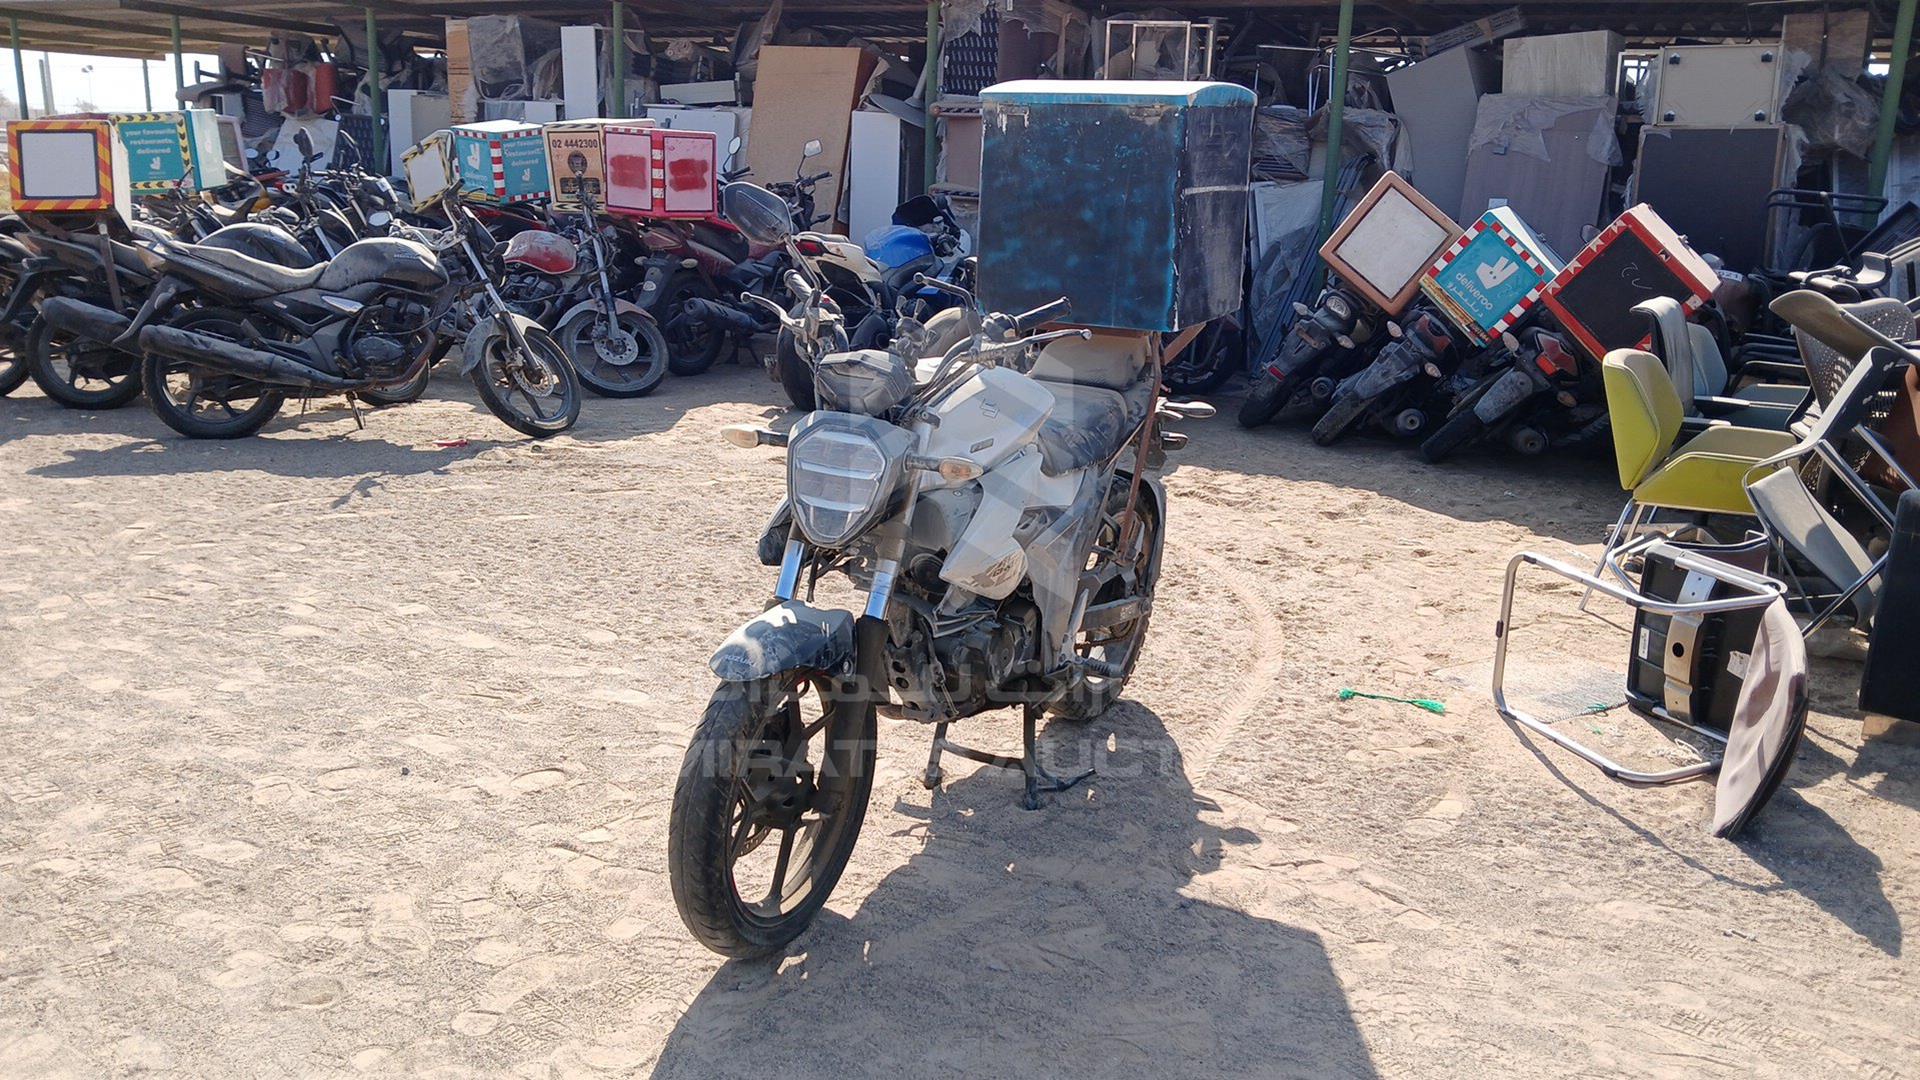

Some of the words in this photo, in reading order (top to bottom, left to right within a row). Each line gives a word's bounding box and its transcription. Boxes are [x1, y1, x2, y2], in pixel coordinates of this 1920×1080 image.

[552, 140, 562, 148] 02
[564, 139, 598, 148] 4442300
[1455, 272, 1494, 311] deliveroo
